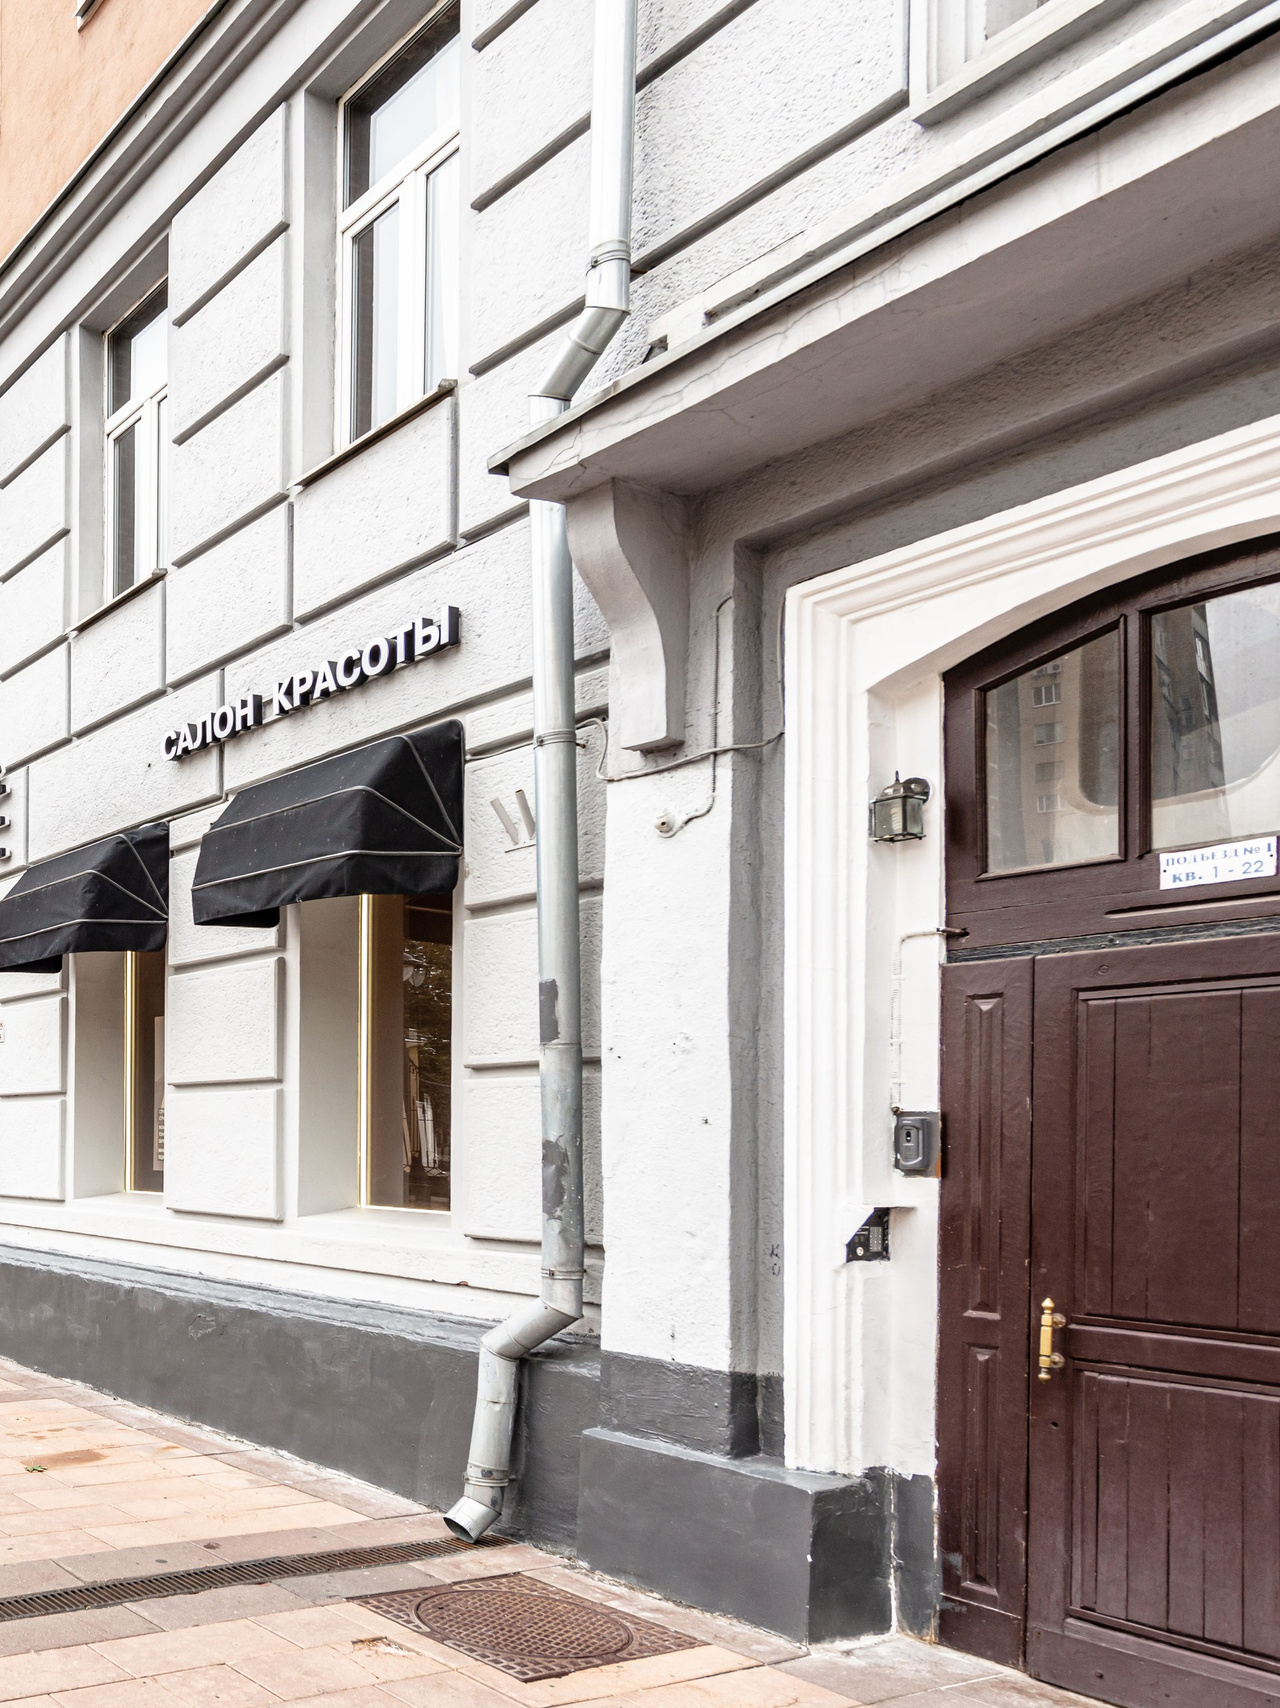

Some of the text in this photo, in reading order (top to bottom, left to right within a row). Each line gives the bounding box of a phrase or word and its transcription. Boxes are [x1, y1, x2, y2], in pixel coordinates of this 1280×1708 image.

[161, 605, 460, 762] САЛОН КРАСОТЫ
[1166, 848, 1240, 867] ПОДЪЕЗД
[1172, 871, 1203, 884] КВ.
[1242, 860, 1264, 875] 22
